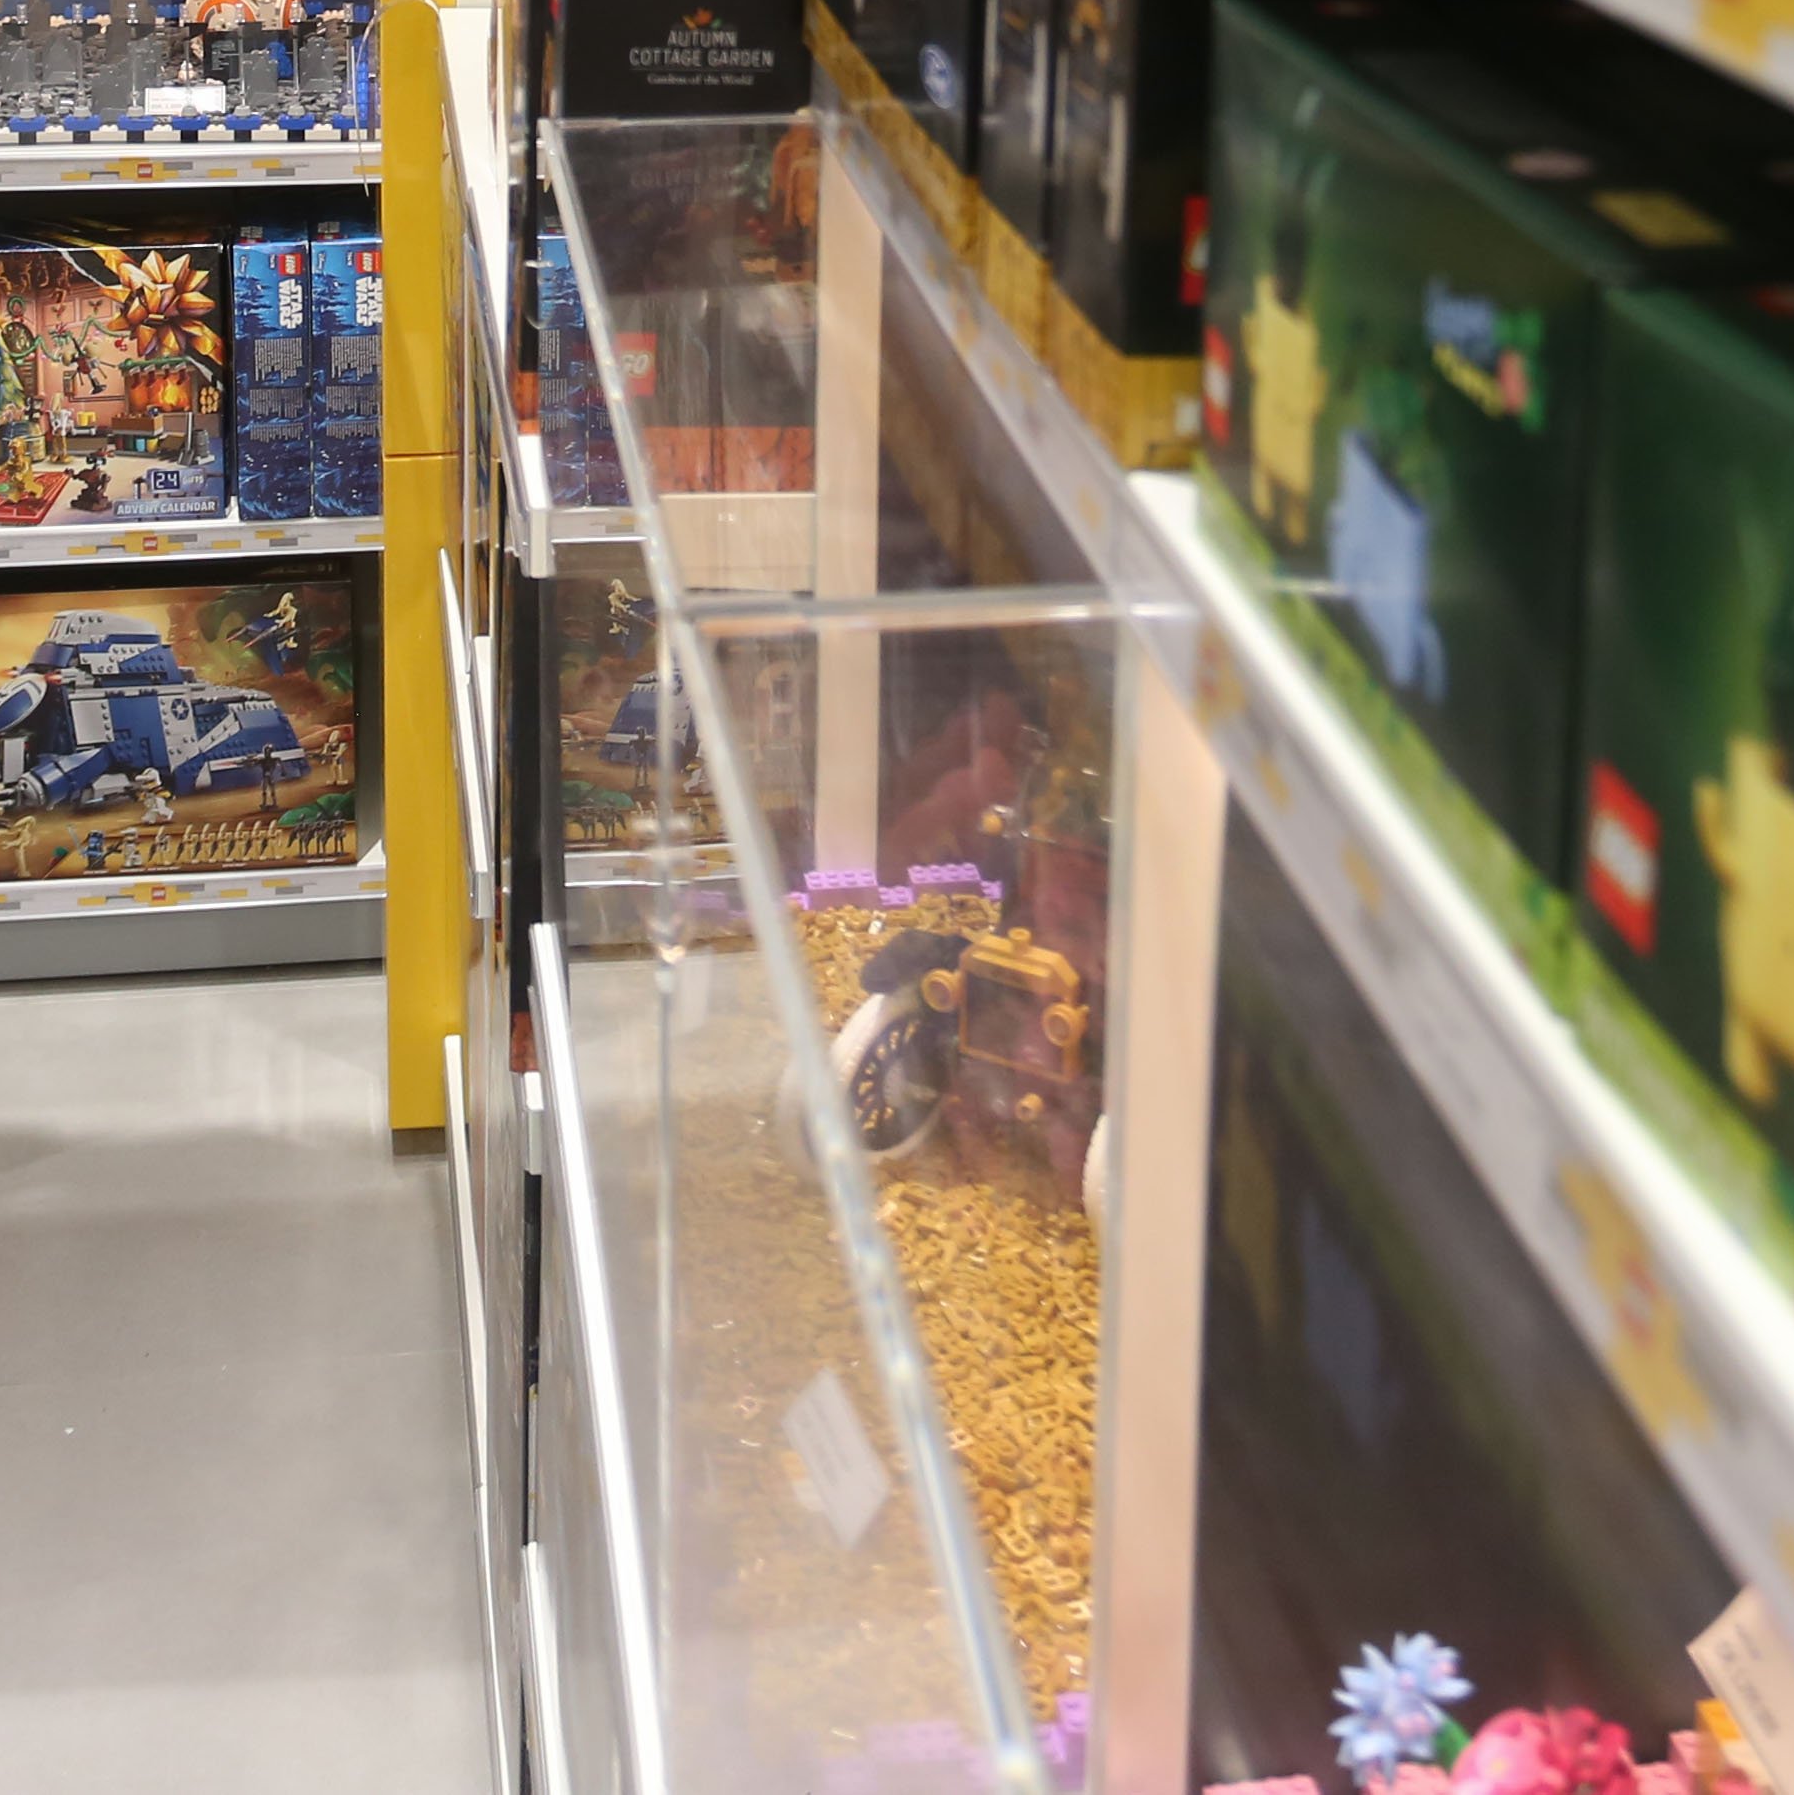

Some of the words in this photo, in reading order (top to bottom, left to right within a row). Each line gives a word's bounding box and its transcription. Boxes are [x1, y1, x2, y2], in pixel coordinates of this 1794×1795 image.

[668, 30, 737, 48] AUTUMN
[629, 49, 702, 68] COTTAGE
[707, 50, 774, 69] GARDEN
[721, 73, 754, 86] World
[156, 473, 178, 489] 24
[116, 504, 158, 515] ADVENT
[160, 501, 215, 514] CALENDAR
